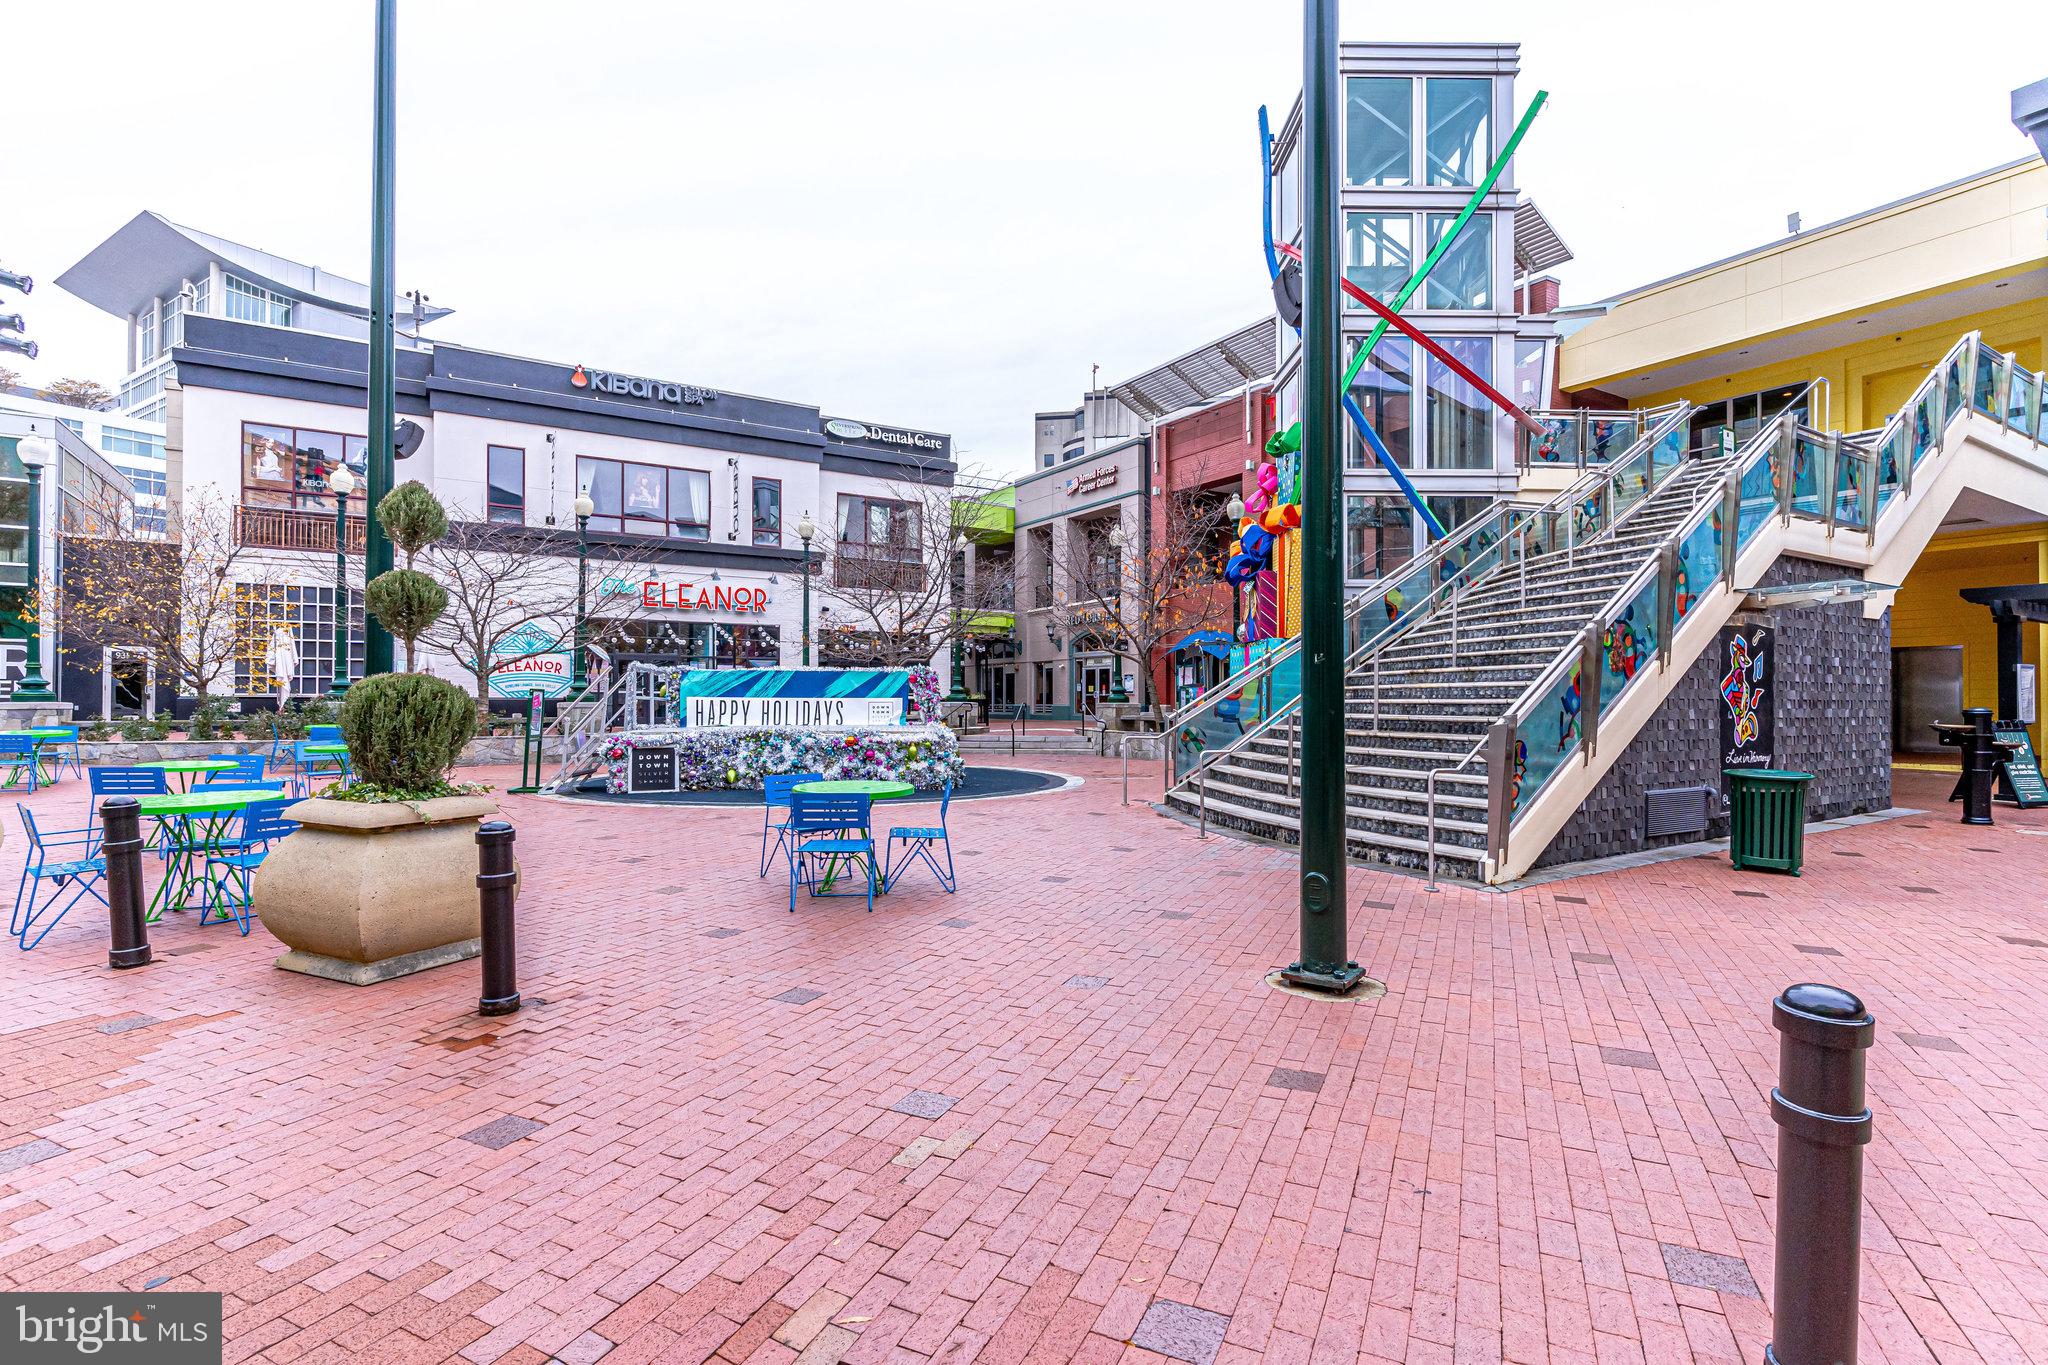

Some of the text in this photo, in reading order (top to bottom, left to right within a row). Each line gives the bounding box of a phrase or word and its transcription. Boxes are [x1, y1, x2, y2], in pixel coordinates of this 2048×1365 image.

[684, 396, 705, 406] SPA
[870, 426, 911, 444] Dental
[914, 433, 943, 448] Care
[1078, 465, 1117, 483] Armed Forces
[1079, 476, 1117, 493] Career Center
[600, 576, 638, 596] The
[642, 581, 768, 613] ELEANOR
[498, 659, 563, 674] ELEANOR
[695, 699, 844, 726] HAPPY HOLIDAYS
